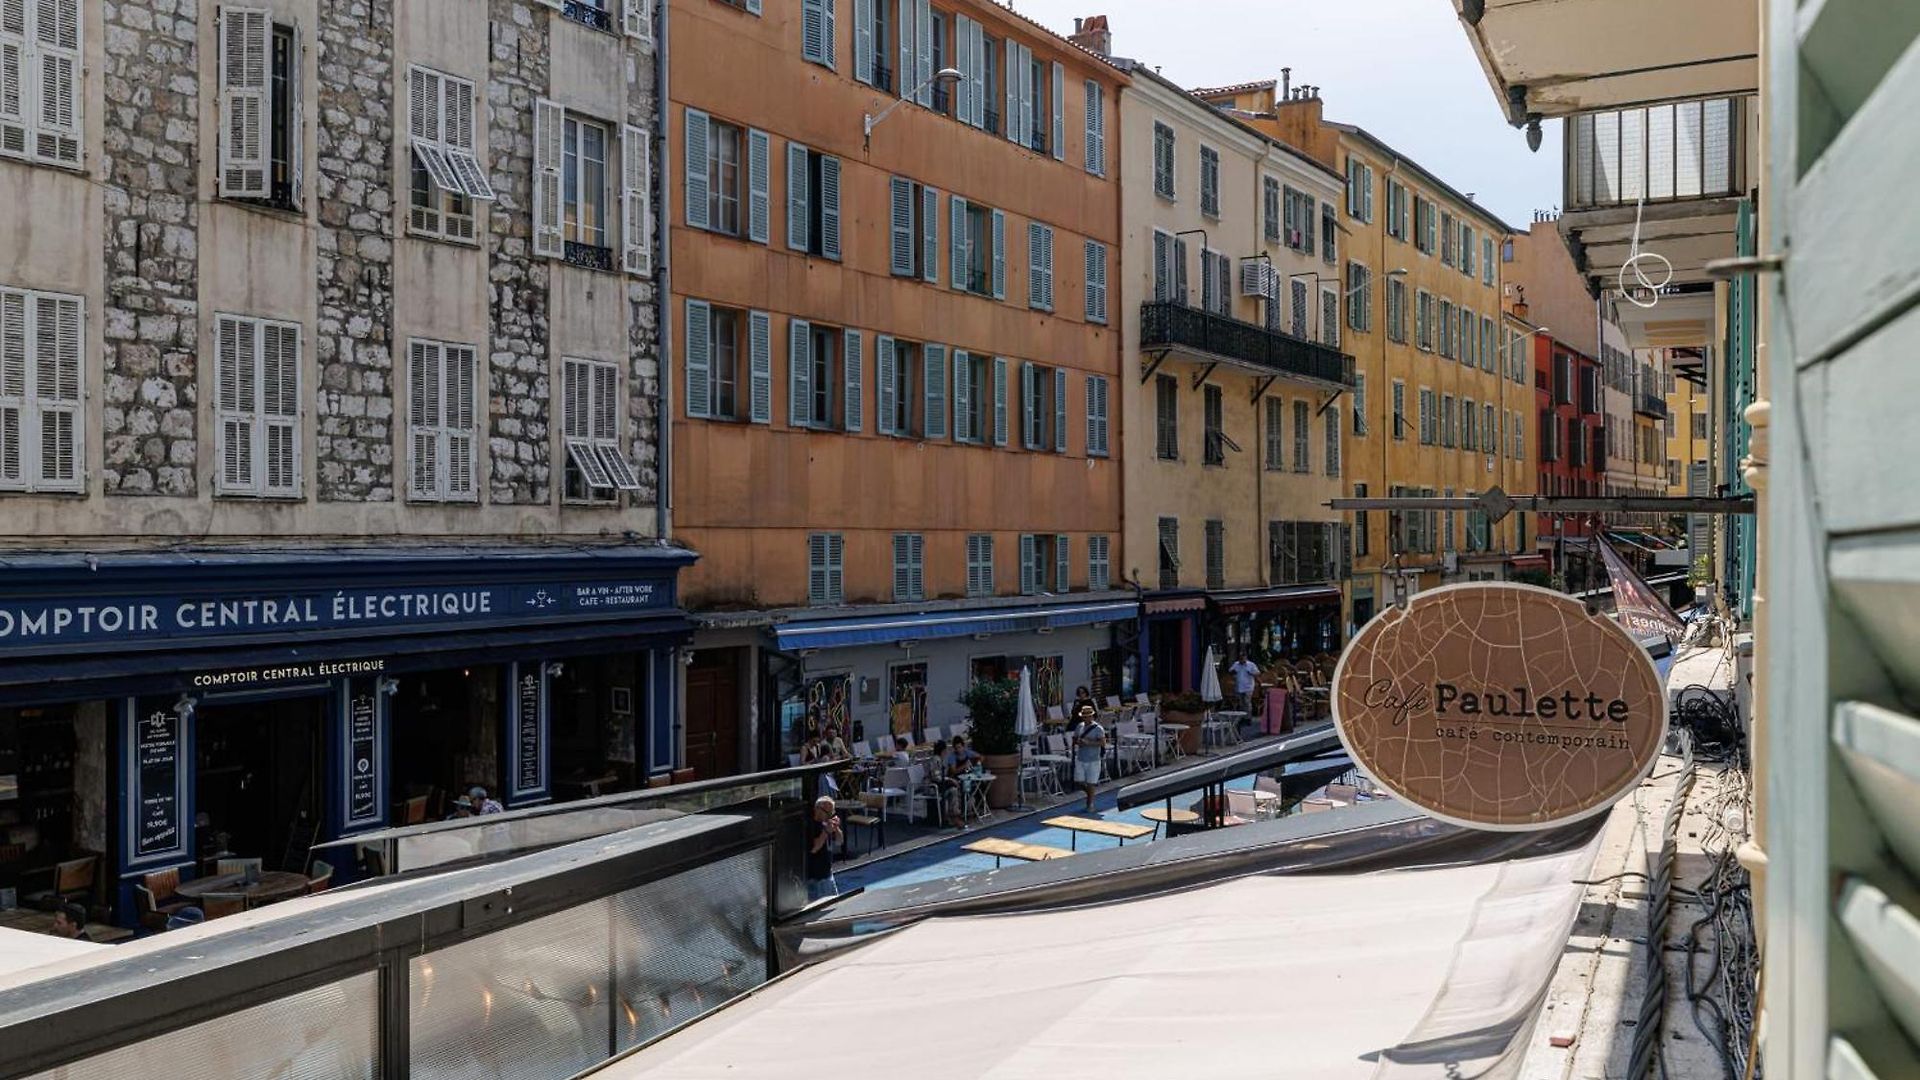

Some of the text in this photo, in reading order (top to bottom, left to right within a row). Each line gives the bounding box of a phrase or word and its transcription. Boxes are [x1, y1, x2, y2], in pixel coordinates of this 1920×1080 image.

[176, 599, 318, 628] CENTRAL
[332, 590, 492, 620] ÉLECTRIQUE
[605, 595, 649, 605] RESTAURANT
[194, 660, 385, 687] COMPTOIR CENTRAL ÉLECTRIQUE
[1435, 683, 1630, 723] Paulette
[1435, 726, 1630, 750] café contemporain
